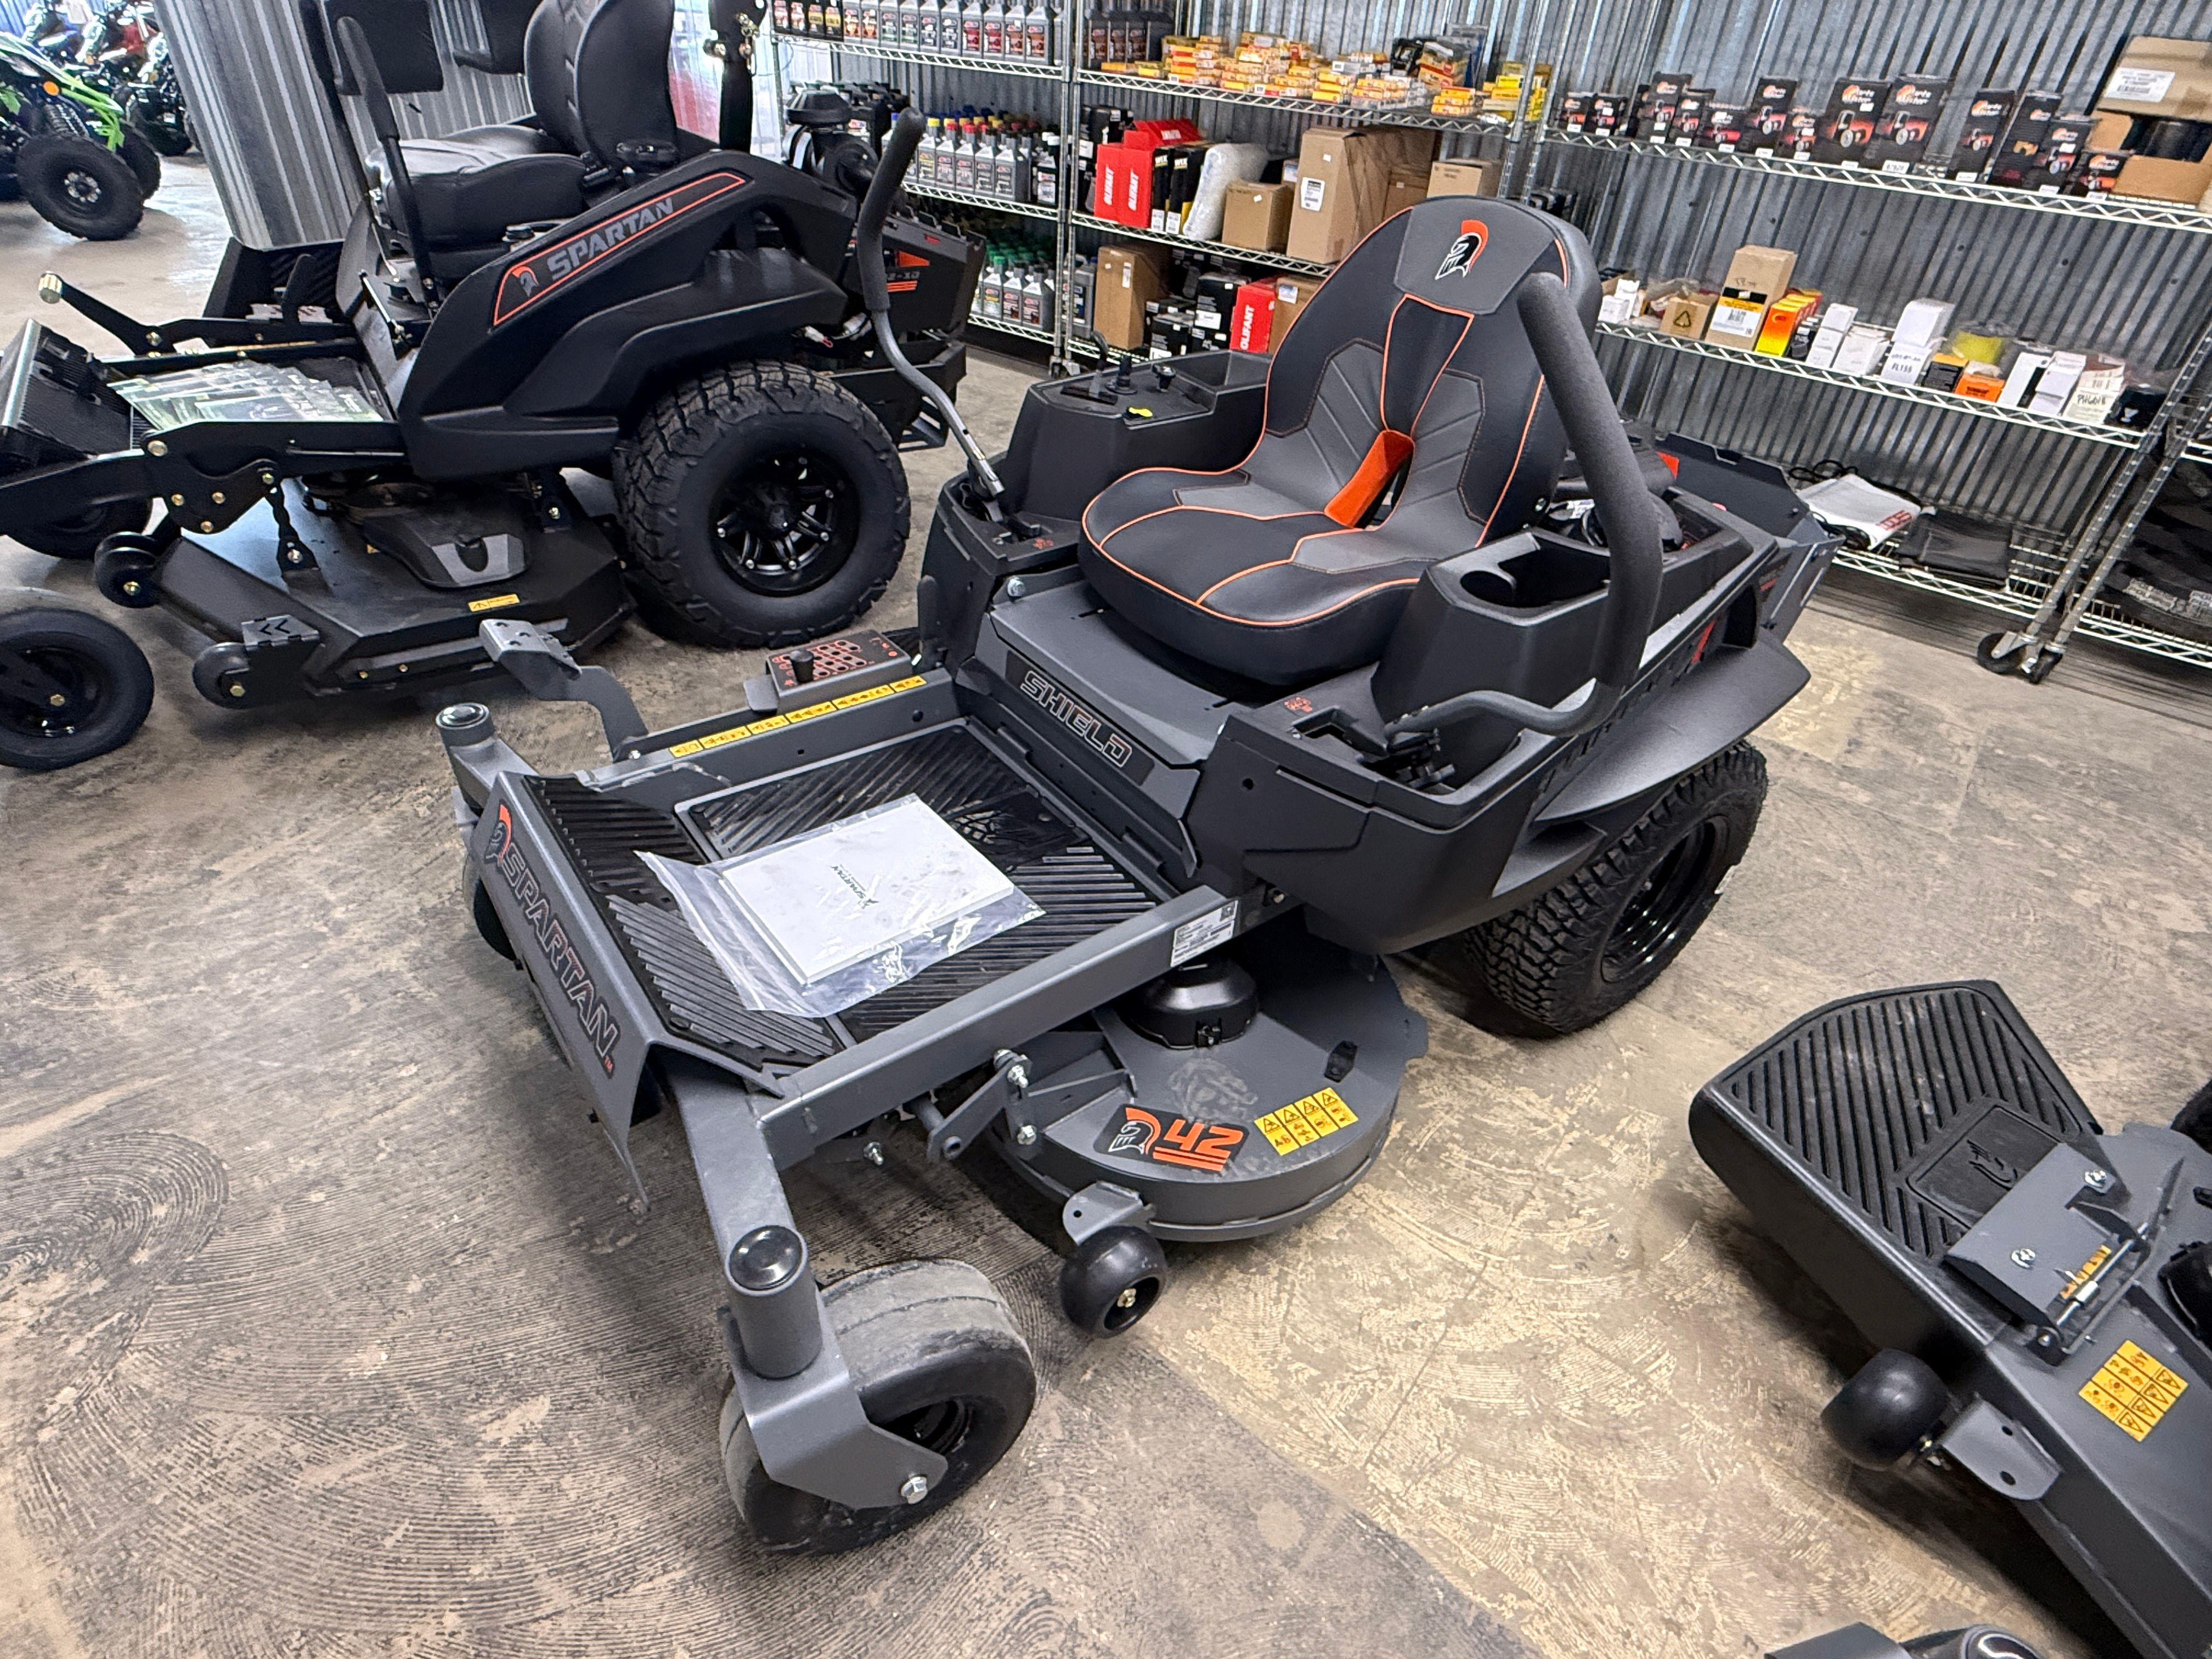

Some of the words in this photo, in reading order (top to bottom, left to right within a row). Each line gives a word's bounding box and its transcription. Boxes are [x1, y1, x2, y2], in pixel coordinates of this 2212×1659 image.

[547, 198, 674, 281] SPARTAN
[1020, 670, 1132, 768] SHIELD
[501, 842, 619, 1058] SPARTAN
[1164, 1118, 1244, 1159] 42
